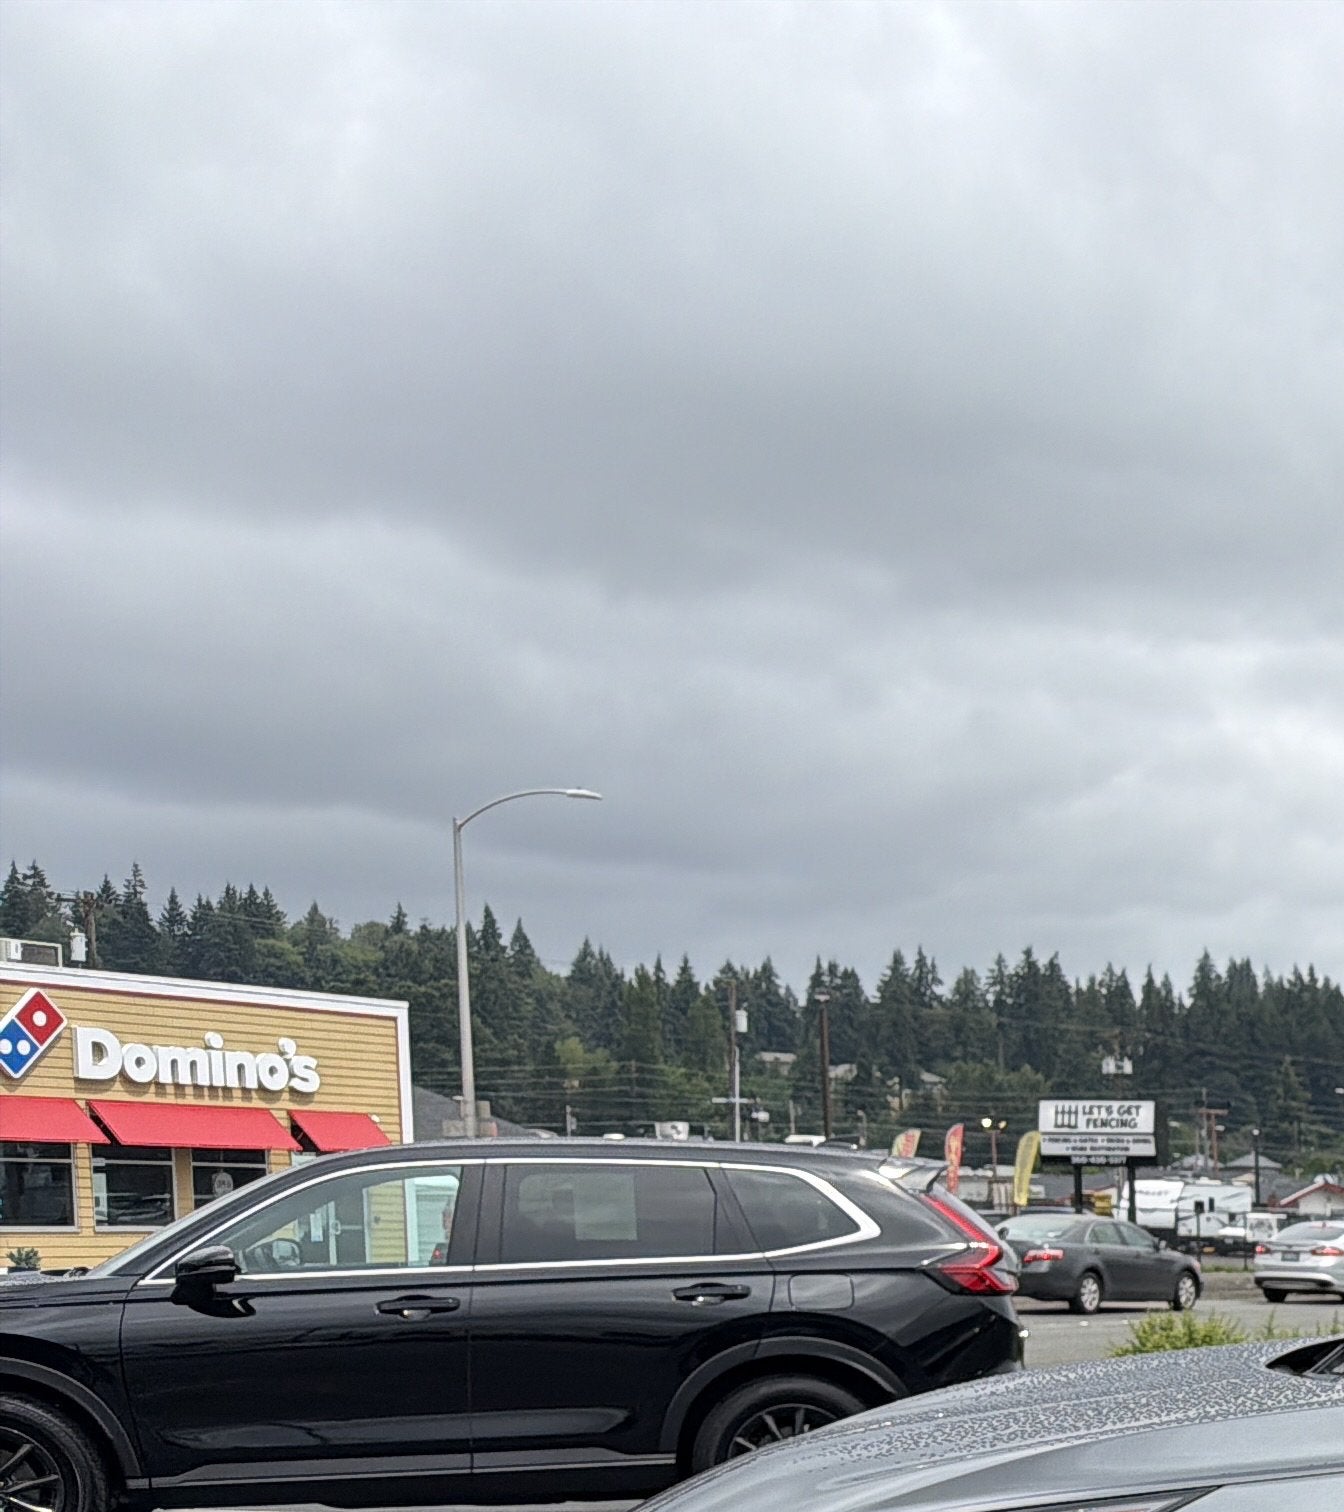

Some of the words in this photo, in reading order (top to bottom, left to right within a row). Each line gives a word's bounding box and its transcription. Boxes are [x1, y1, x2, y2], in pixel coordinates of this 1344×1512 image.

[72, 1025, 321, 1093] Domino's
[1082, 1104, 1114, 1117] LET'S
[1117, 1104, 1142, 1117] GET
[1085, 1117, 1138, 1129] FENCING
